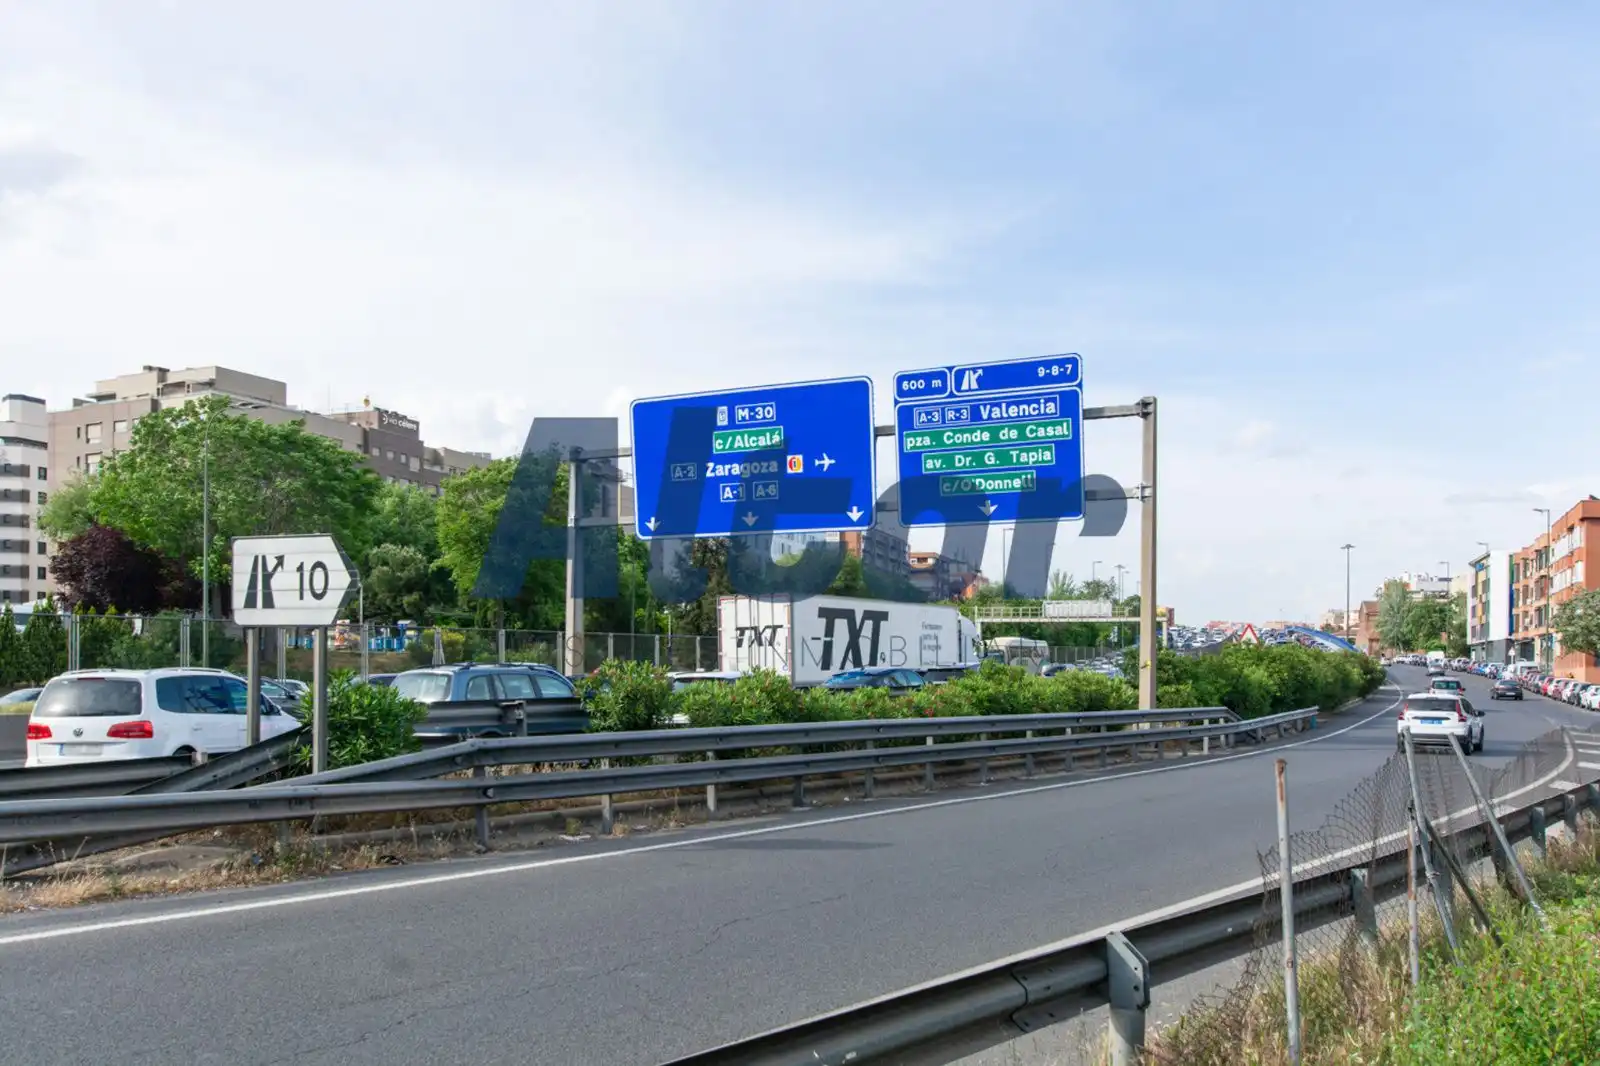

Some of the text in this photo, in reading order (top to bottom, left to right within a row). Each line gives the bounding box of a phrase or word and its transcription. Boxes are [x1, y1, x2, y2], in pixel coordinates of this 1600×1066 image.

[1037, 363, 1073, 377] 9-8-7
[901, 378, 942, 391] 600 m
[738, 406, 773, 421] M-30
[919, 399, 1057, 423] A-3 R-3 Valencia
[715, 430, 781, 450] c/Alcalá
[906, 421, 1070, 449] pza. Conde de Casal
[925, 448, 1053, 470] av. Dr. G. Tapia
[674, 460, 779, 479] A-2 Zaragoza
[723, 483, 777, 499] A-1 A-6
[942, 473, 1033, 493] c/O'Donnell
[296, 560, 329, 601] 10
[735, 624, 784, 648] TXT
[817, 606, 890, 672] TXT
